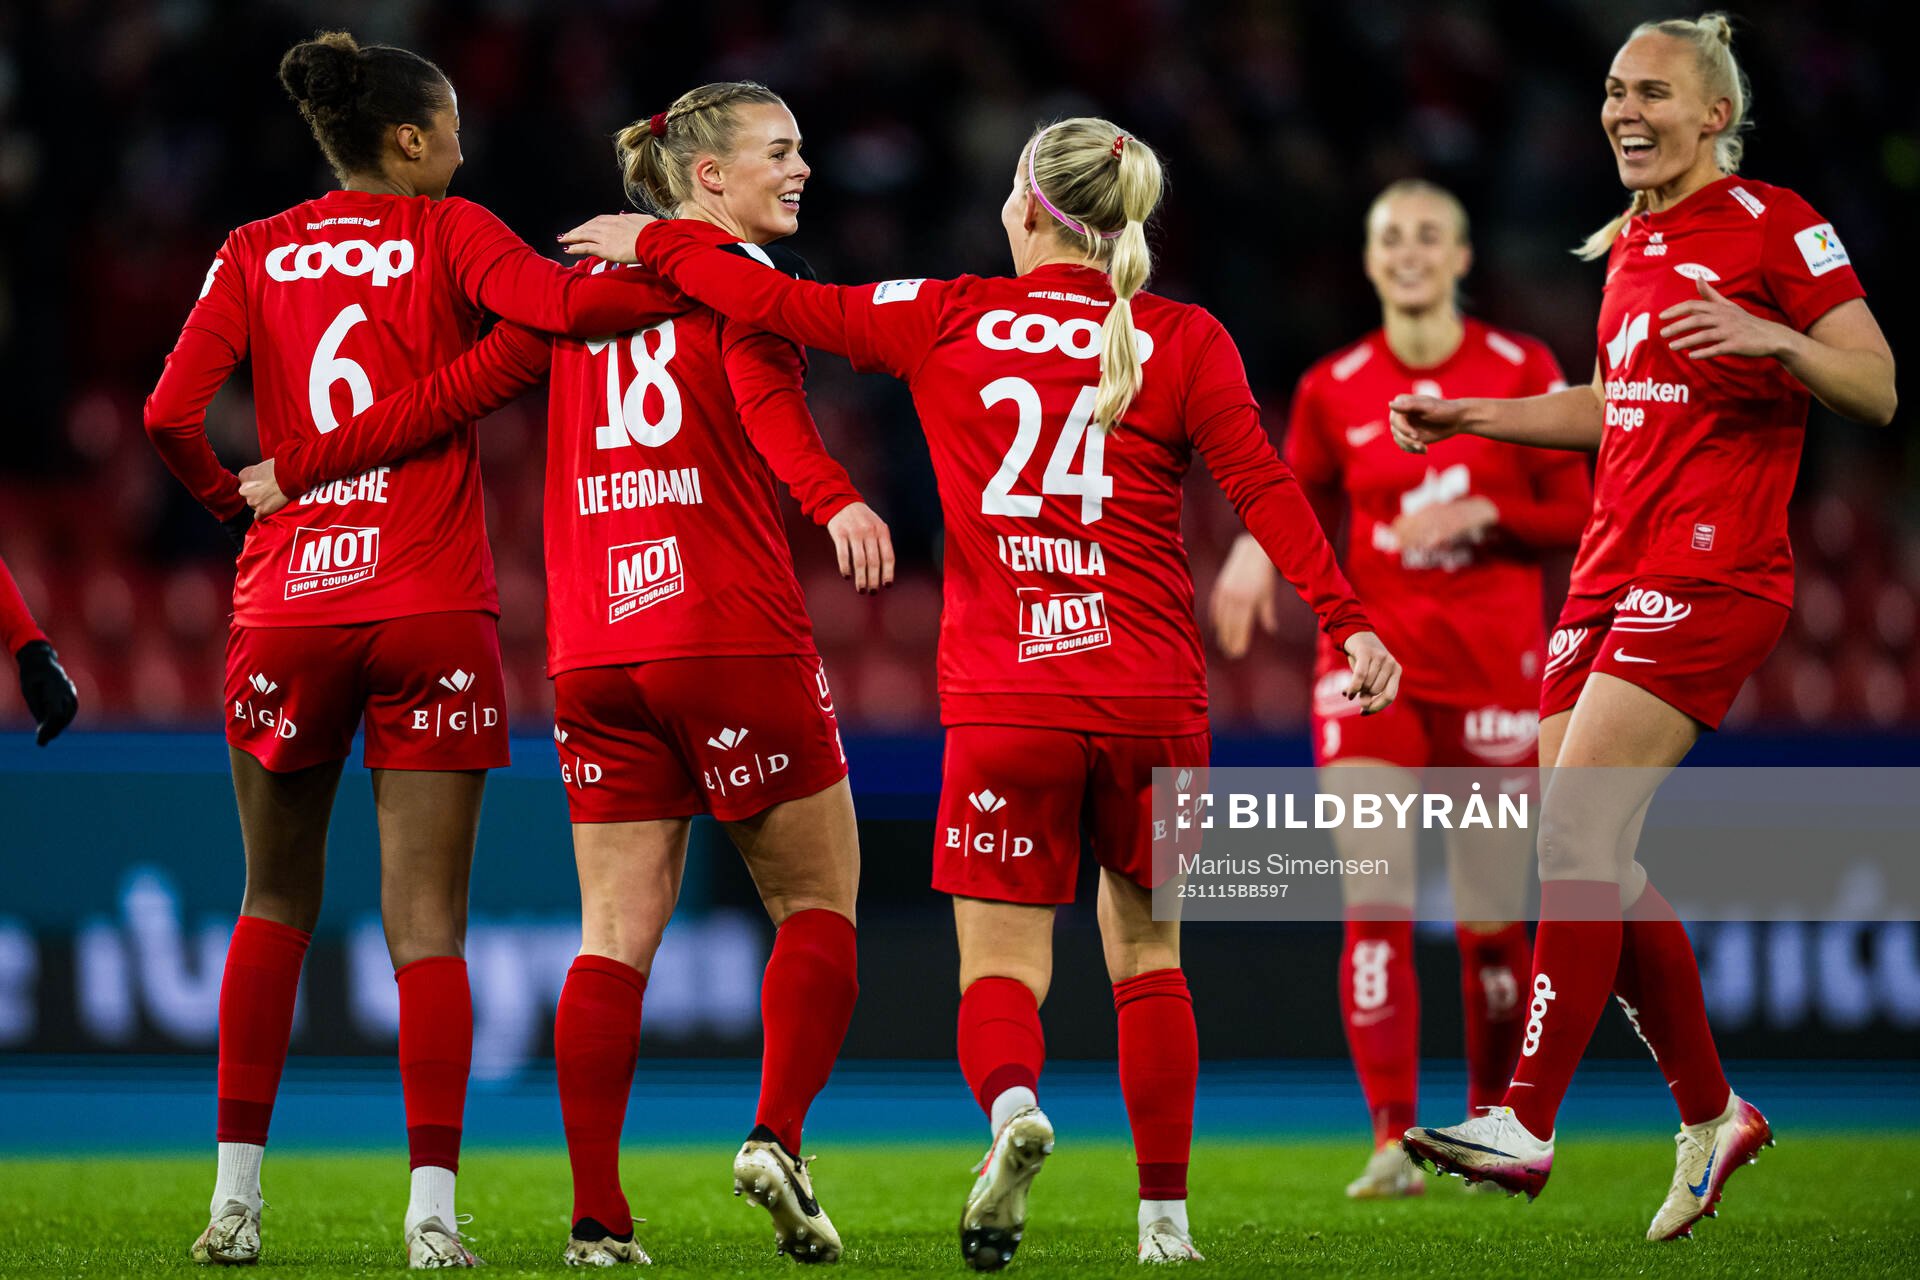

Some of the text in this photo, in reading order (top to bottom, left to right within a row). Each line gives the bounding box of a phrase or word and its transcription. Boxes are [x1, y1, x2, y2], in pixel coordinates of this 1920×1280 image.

[265, 239, 414, 287] coop
[309, 303, 374, 434] 6
[585, 318, 682, 450] 18
[979, 376, 1114, 526] 24
[577, 475, 609, 516] LIE
[299, 529, 378, 573] MOT
[617, 539, 678, 594] MOT
[997, 535, 1106, 576] LEHTOLA
[290, 569, 369, 593] SHOW COURAGE!
[614, 581, 678, 617] SHOW COURAGE!
[1031, 593, 1103, 637] MOT
[1025, 632, 1104, 656] SHOW COURAGE!
[1522, 973, 1557, 1057] coop
